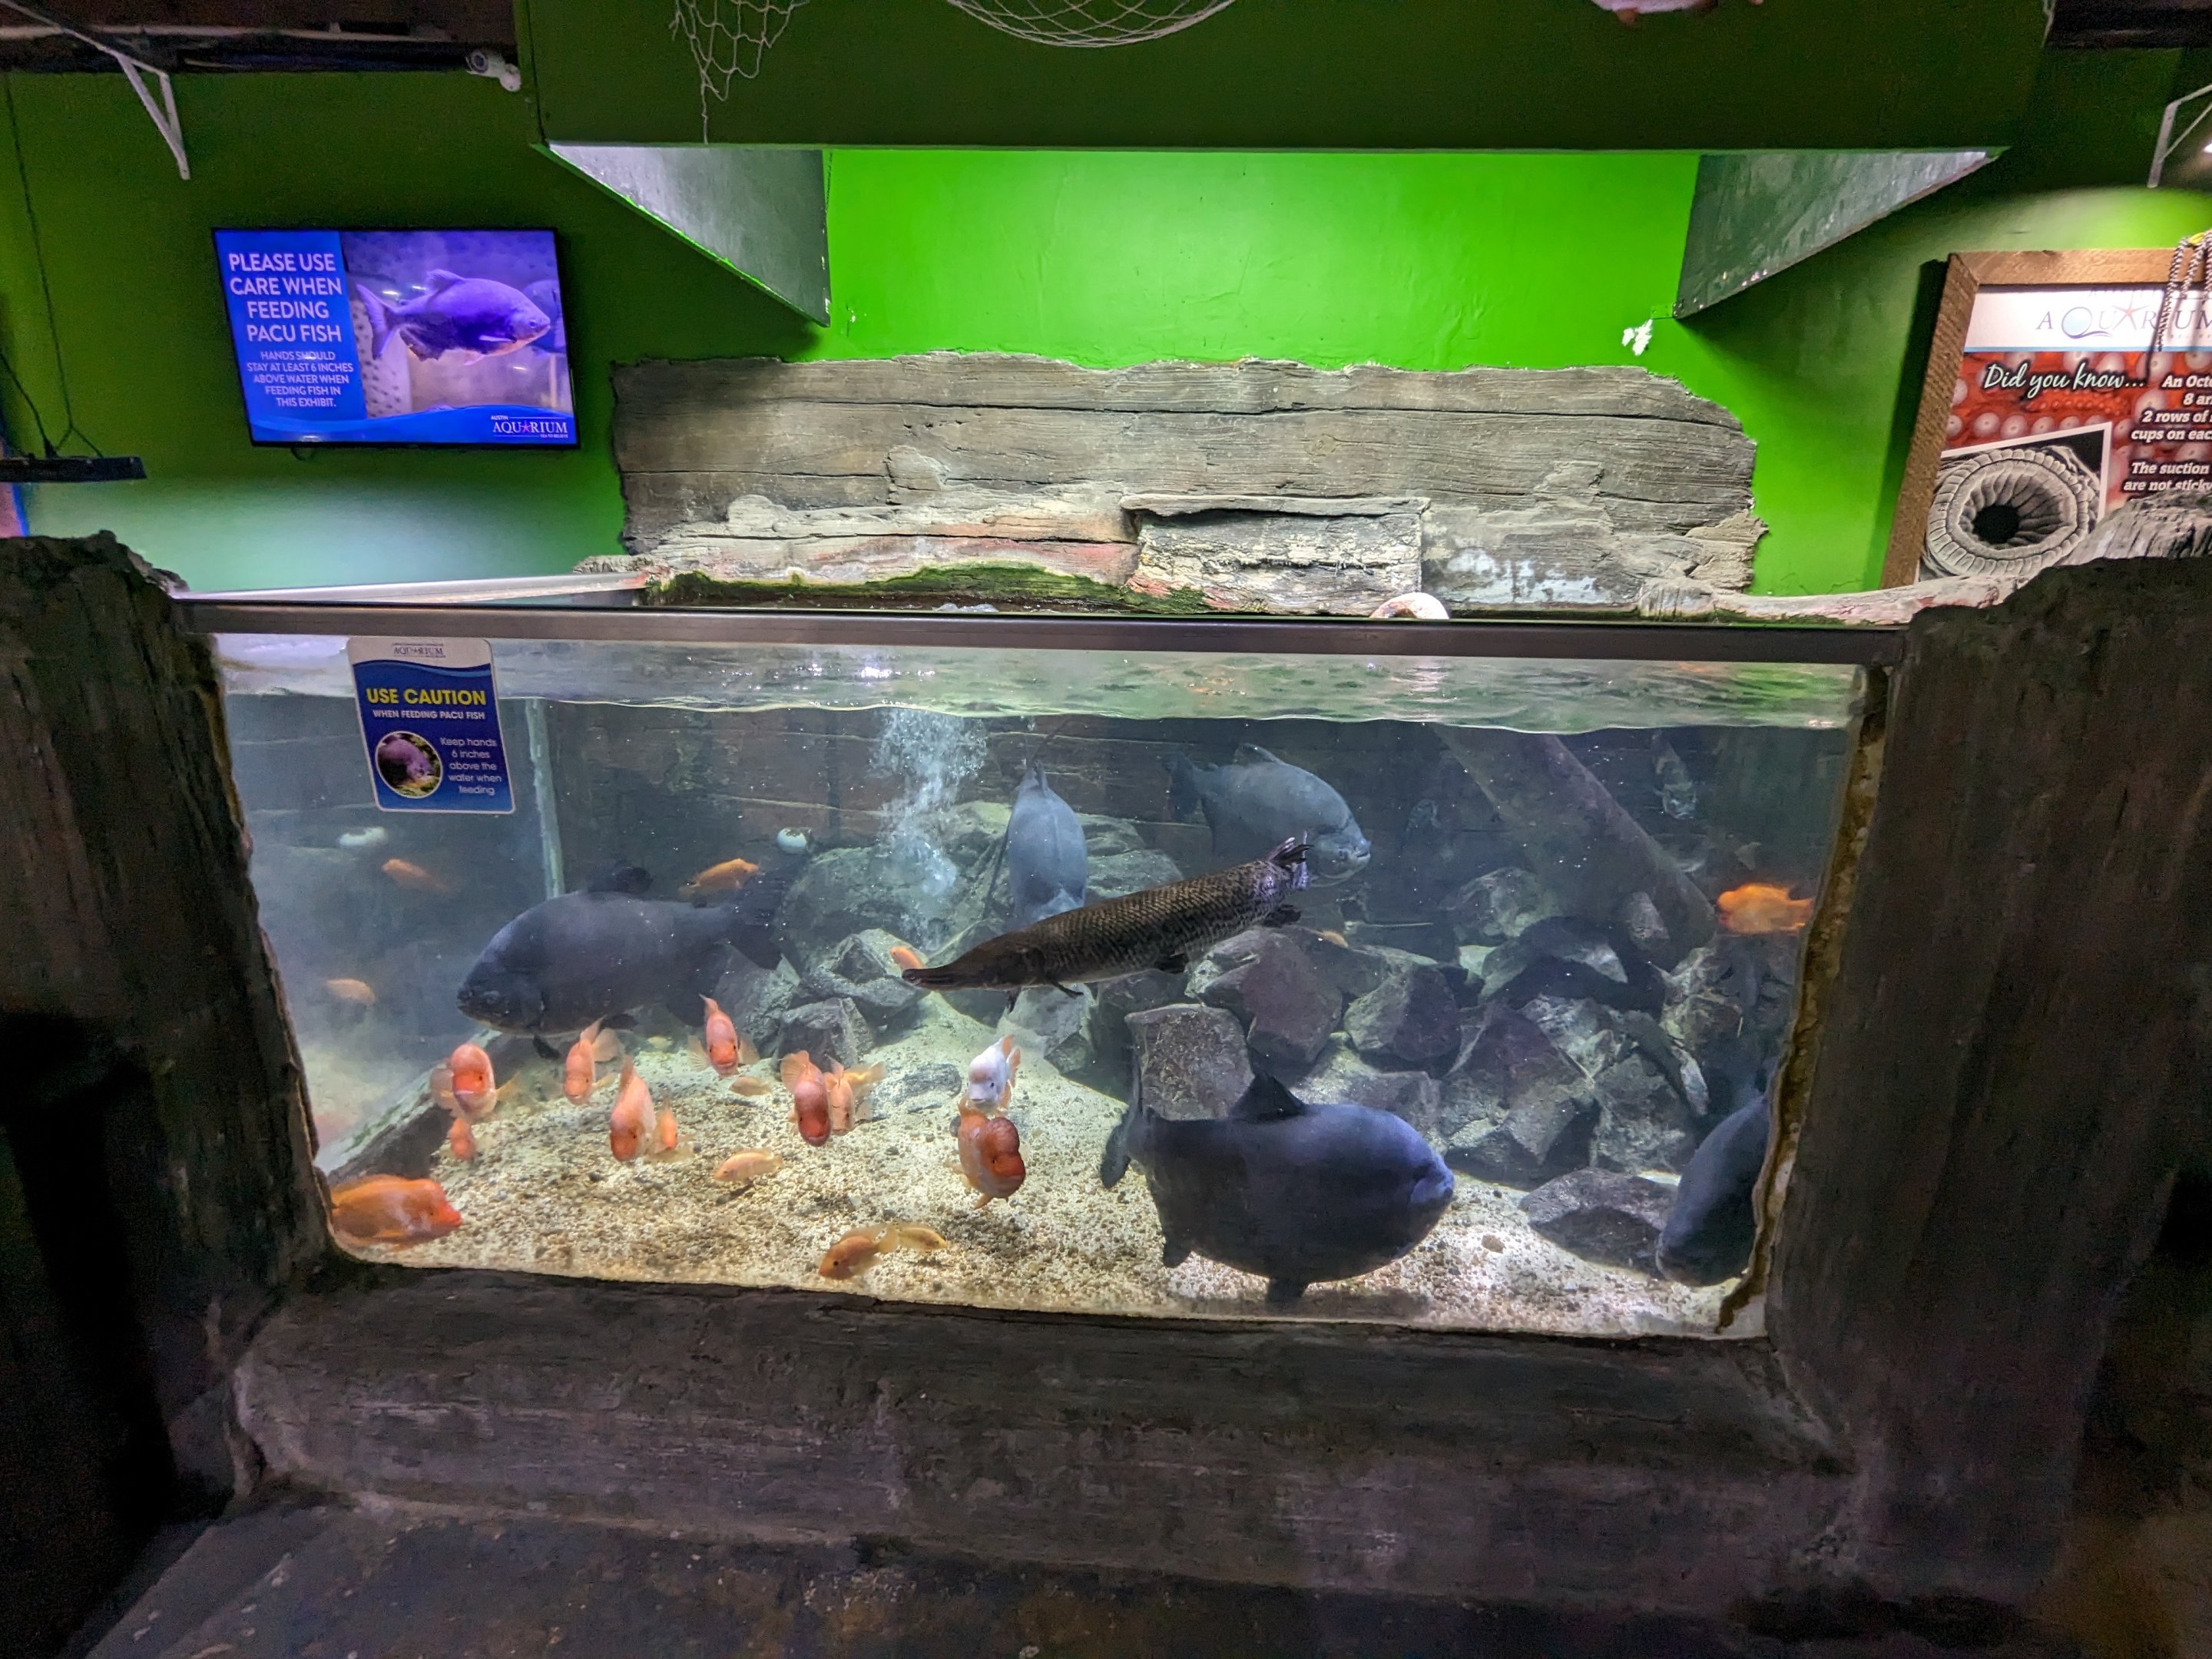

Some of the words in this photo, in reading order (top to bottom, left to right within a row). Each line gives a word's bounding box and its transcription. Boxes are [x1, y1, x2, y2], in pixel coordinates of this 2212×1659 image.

[229, 253, 296, 272] PLEASE
[299, 253, 336, 272] USE
[230, 277, 281, 296] CARE
[283, 277, 343, 296] WHEN
[247, 301, 329, 319] FEEDING
[247, 324, 296, 343] PACU
[300, 324, 343, 343] FISH
[260, 351, 294, 360] HANDS
[295, 351, 336, 360] SHOULD
[247, 363, 269, 372] STAY
[270, 363, 281, 372] AT
[283, 363, 309, 372] LEAST
[311, 363, 316, 372] 6
[318, 363, 354, 373] INCHES
[253, 374, 286, 383] ABOVE
[286, 374, 318, 383] WATER
[319, 374, 349, 383] WHEN
[1984, 362, 2029, 389] Did
[2028, 373, 2070, 399] you
[2072, 362, 2144, 390] know...
[2161, 375, 2184, 388] An
[265, 386, 306, 396] FEEDING
[307, 386, 329, 396] FISH
[330, 386, 341, 396] IN
[276, 397, 297, 407] THIS
[299, 397, 336, 407] EXHIBIT.
[2183, 392, 2194, 406] 8
[2142, 410, 2153, 422] 2
[2154, 412, 2190, 422] rows
[2193, 409, 2210, 422] of
[2131, 429, 2164, 443] cups
[2167, 429, 2186, 440] on
[2131, 462, 2157, 474] The
[2159, 462, 2210, 475] suction
[2123, 481, 2146, 491] are
[2148, 480, 2173, 491] not
[366, 688, 399, 704] USE
[403, 689, 487, 706] CAUTION
[373, 710, 399, 718] WHEN
[400, 710, 438, 719] FEEDING
[439, 710, 464, 720] PACU
[466, 711, 486, 720] FISH
[440, 737, 465, 747] Keep
[467, 738, 498, 747] hands
[452, 750, 458, 758] 6
[449, 761, 480, 770] above
[476, 774, 502, 783] when
